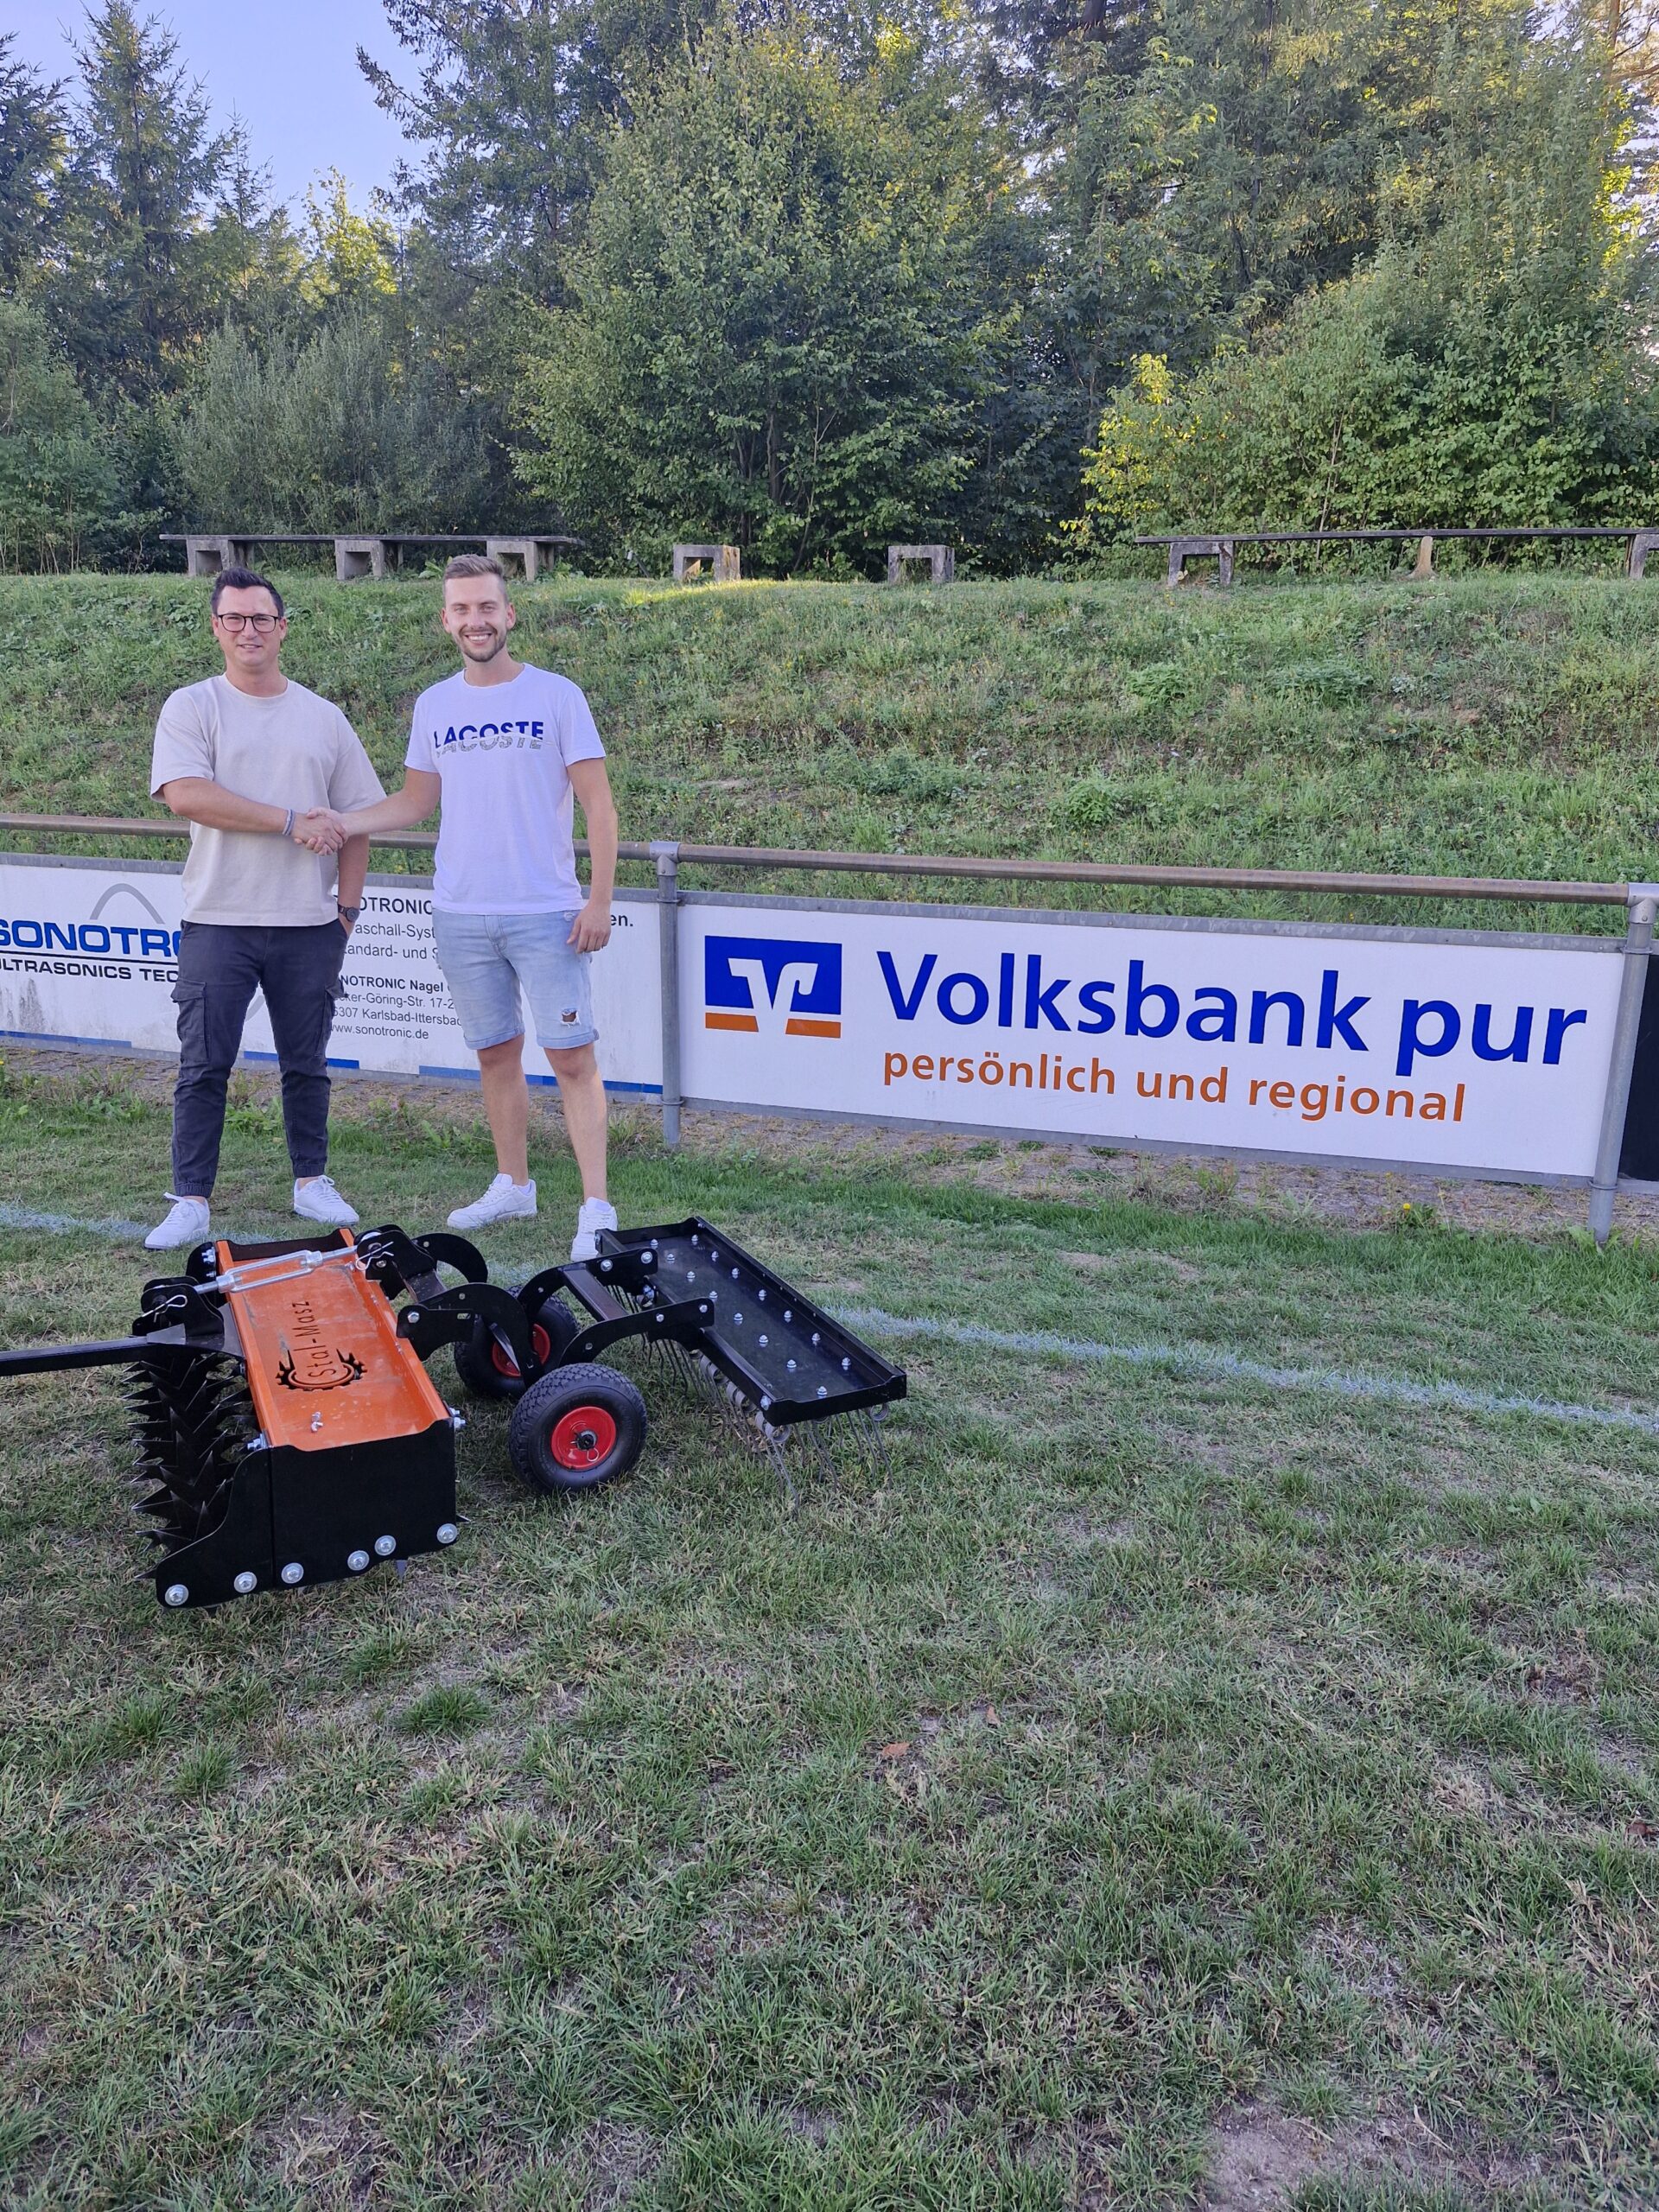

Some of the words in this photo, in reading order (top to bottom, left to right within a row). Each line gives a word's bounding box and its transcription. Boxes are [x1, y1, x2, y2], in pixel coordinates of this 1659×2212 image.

[433, 721, 544, 757] LACOSTE
[0, 918, 181, 957] ONOTR
[403, 947, 428, 960] und
[0, 958, 132, 980] LTRASONICS
[410, 979, 443, 995] Nagel
[876, 950, 1372, 1052] Volksbank
[1395, 998, 1588, 1077] pur
[884, 1051, 1116, 1095] persönlich
[1136, 1066, 1229, 1103] und
[1249, 1075, 1466, 1122] regional
[292, 1301, 337, 1377] Stal-Masz
